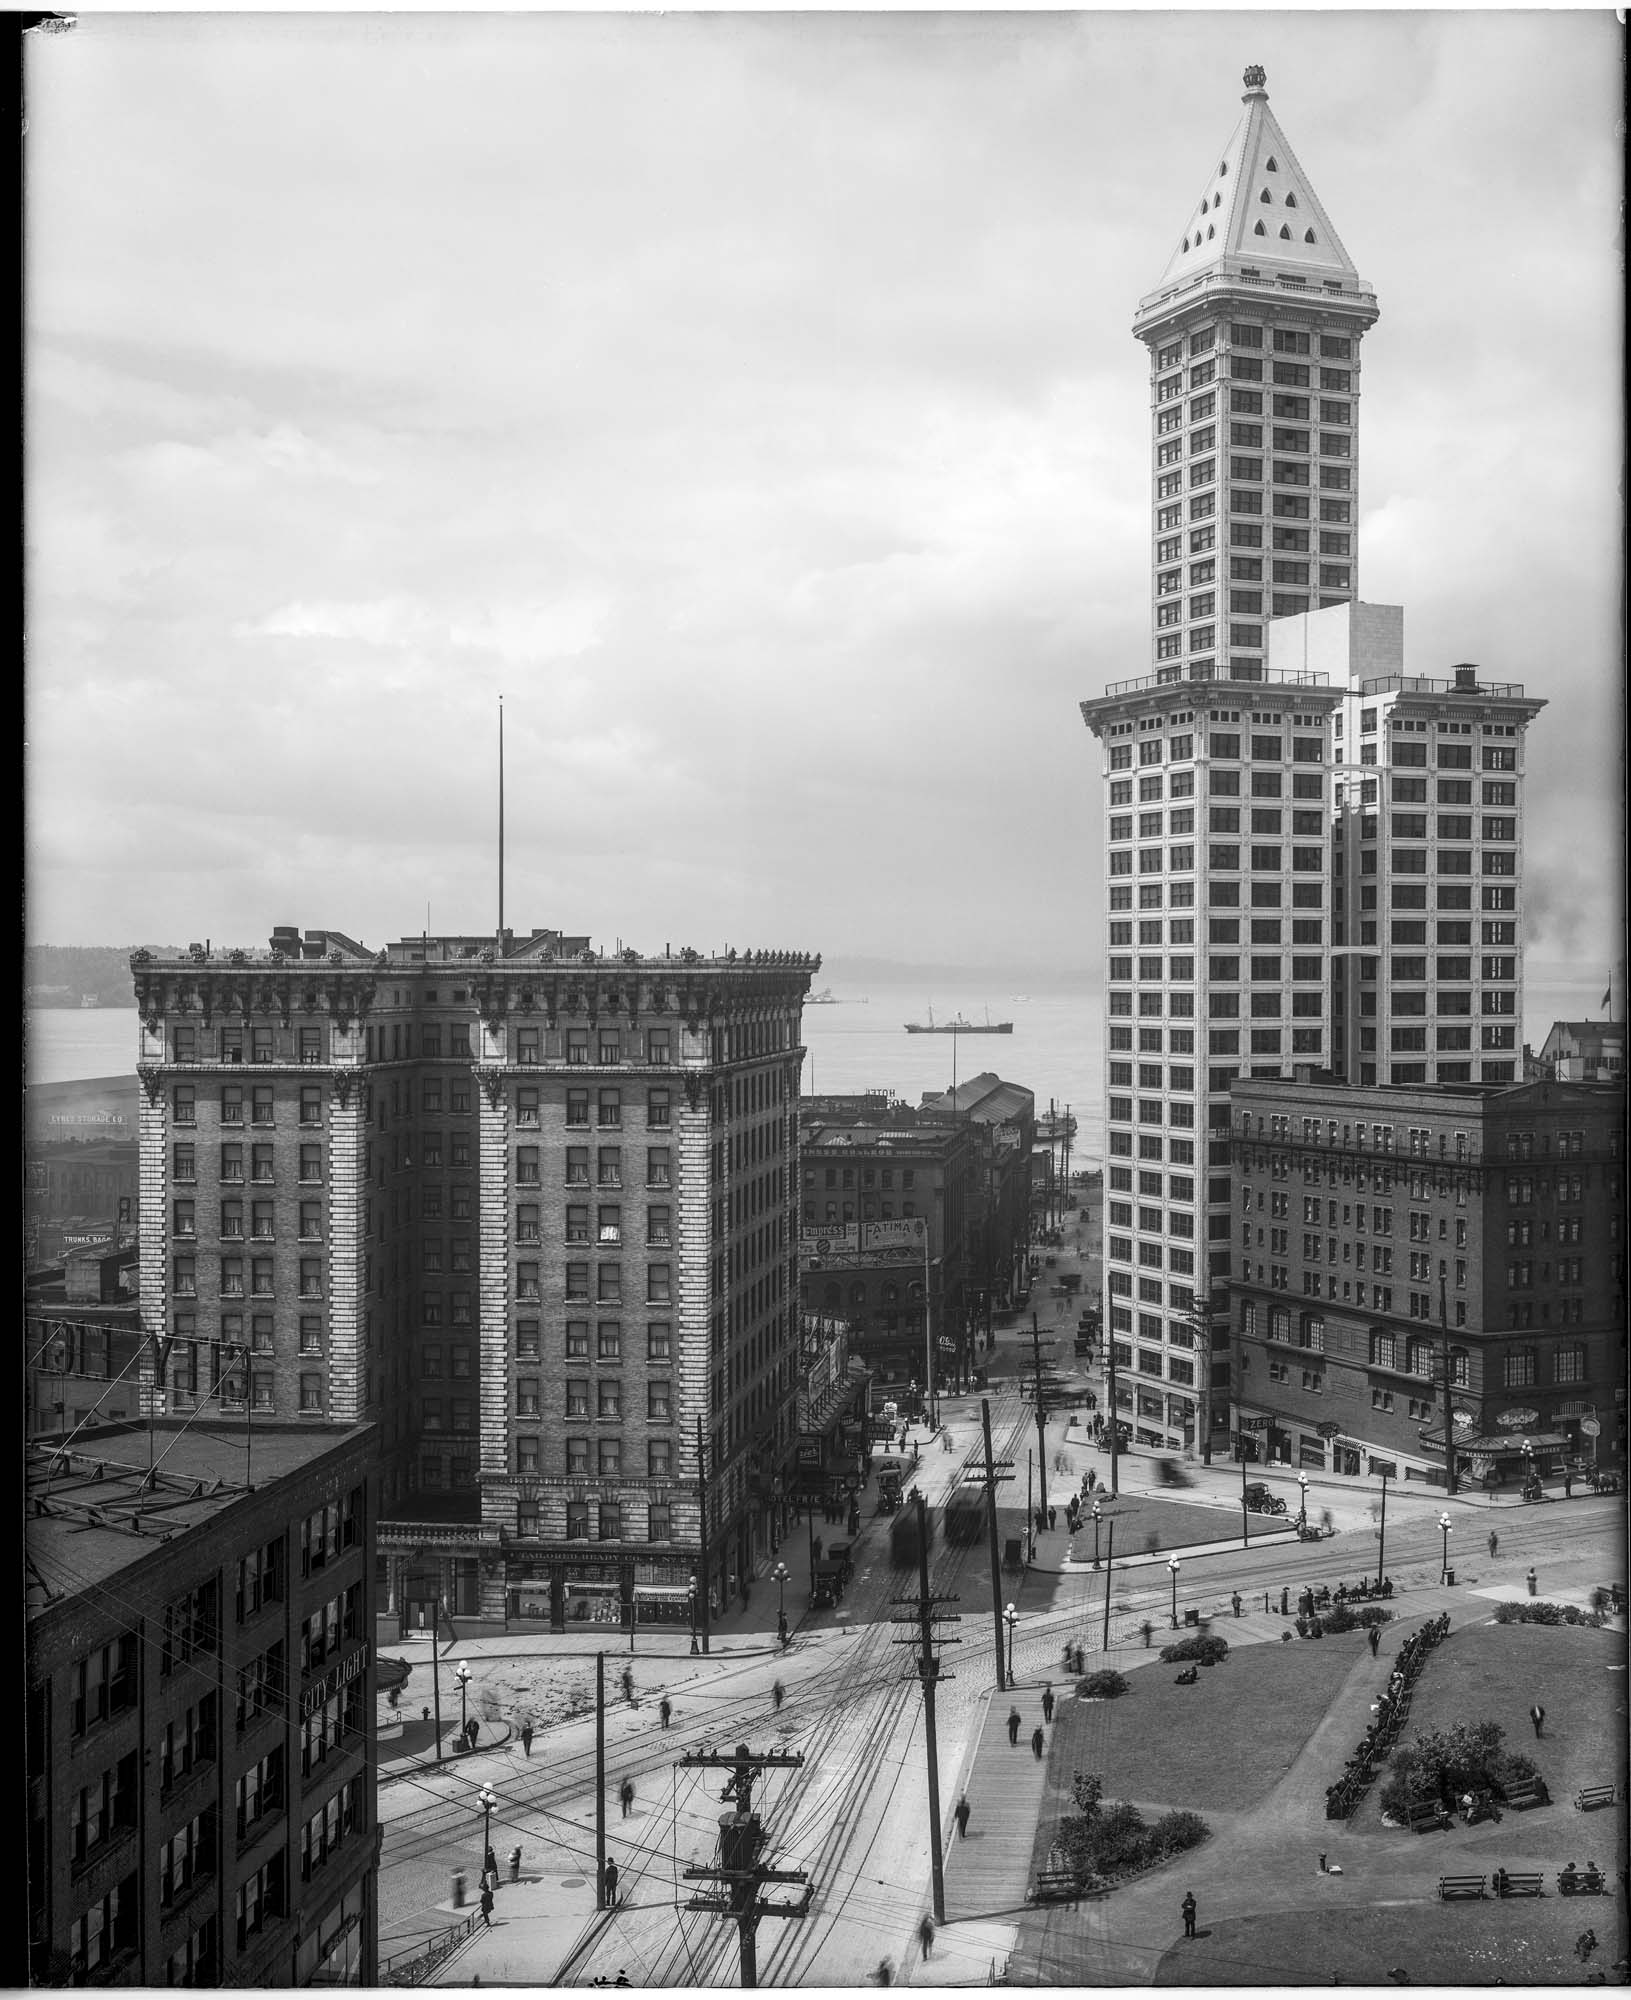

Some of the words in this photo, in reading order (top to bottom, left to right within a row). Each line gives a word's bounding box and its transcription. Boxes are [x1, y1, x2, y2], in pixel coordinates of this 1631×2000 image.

[866, 1222, 911, 1248] FATIMA
[1250, 1419, 1274, 1429] ZERO
[304, 1676, 329, 1717] CITY
[336, 1644, 368, 1688] LIGHT
